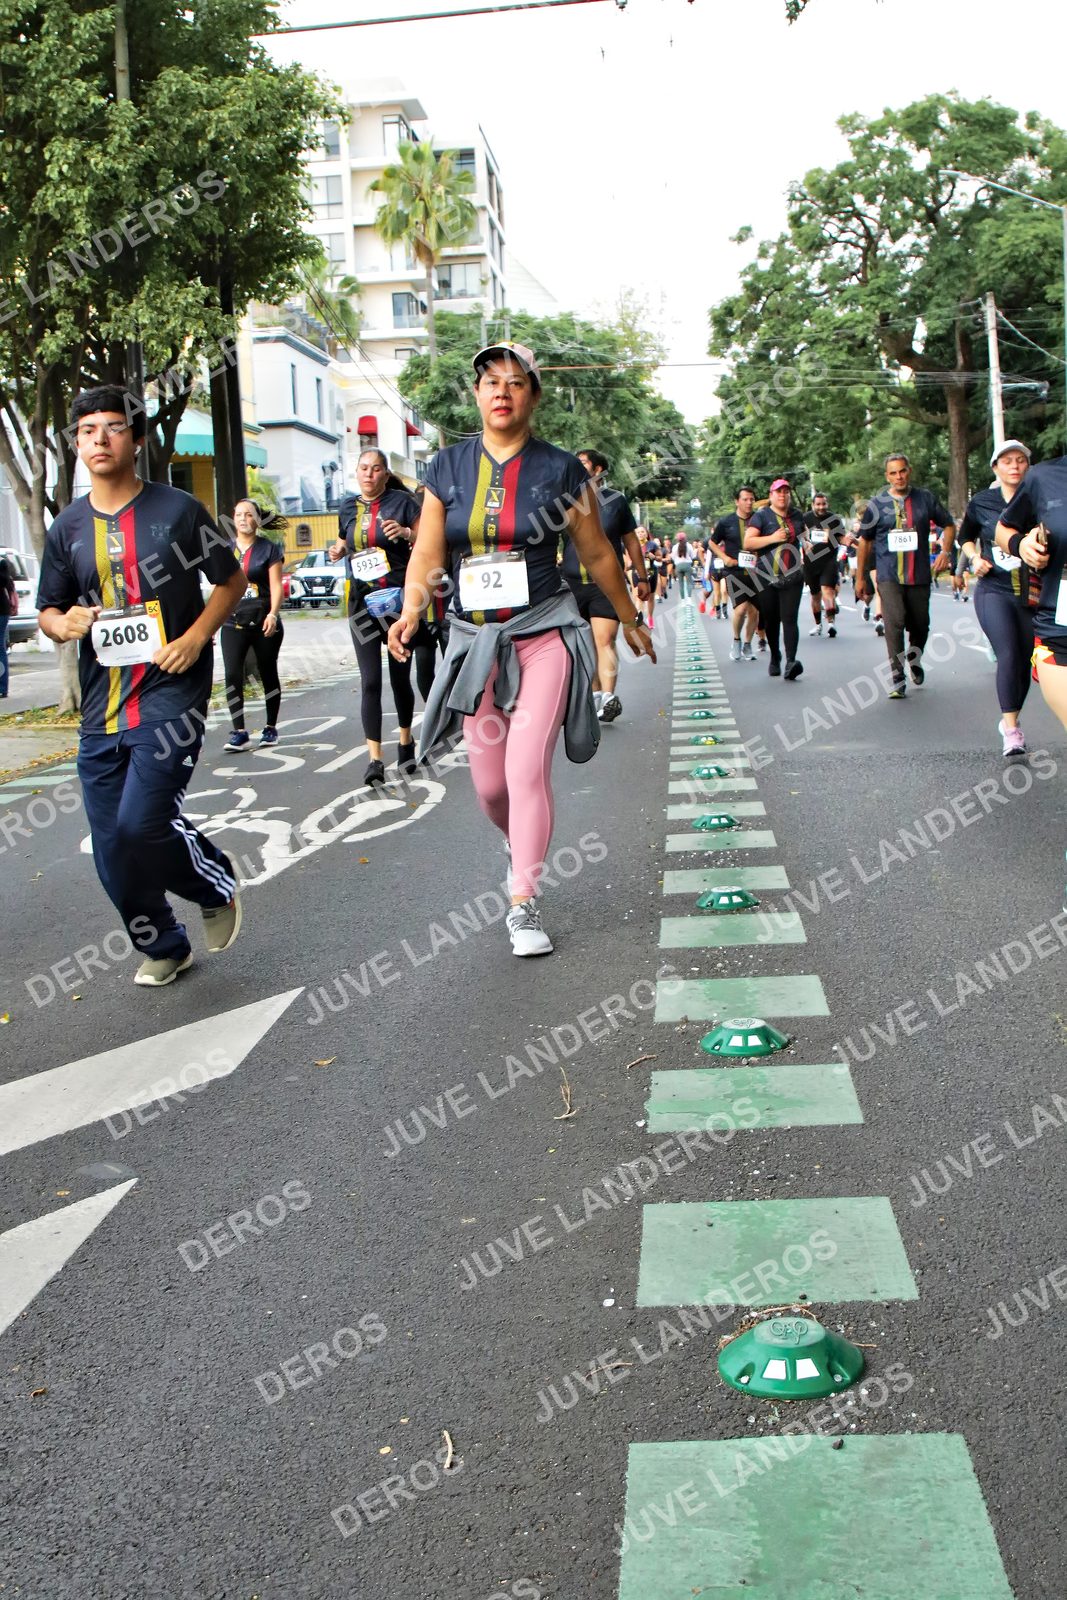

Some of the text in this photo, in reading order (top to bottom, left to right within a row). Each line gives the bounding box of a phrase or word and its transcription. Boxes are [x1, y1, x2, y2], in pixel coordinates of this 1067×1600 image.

[356, 557, 380, 572] 5932
[481, 570, 503, 589] 92
[100, 622, 149, 647] 2608
